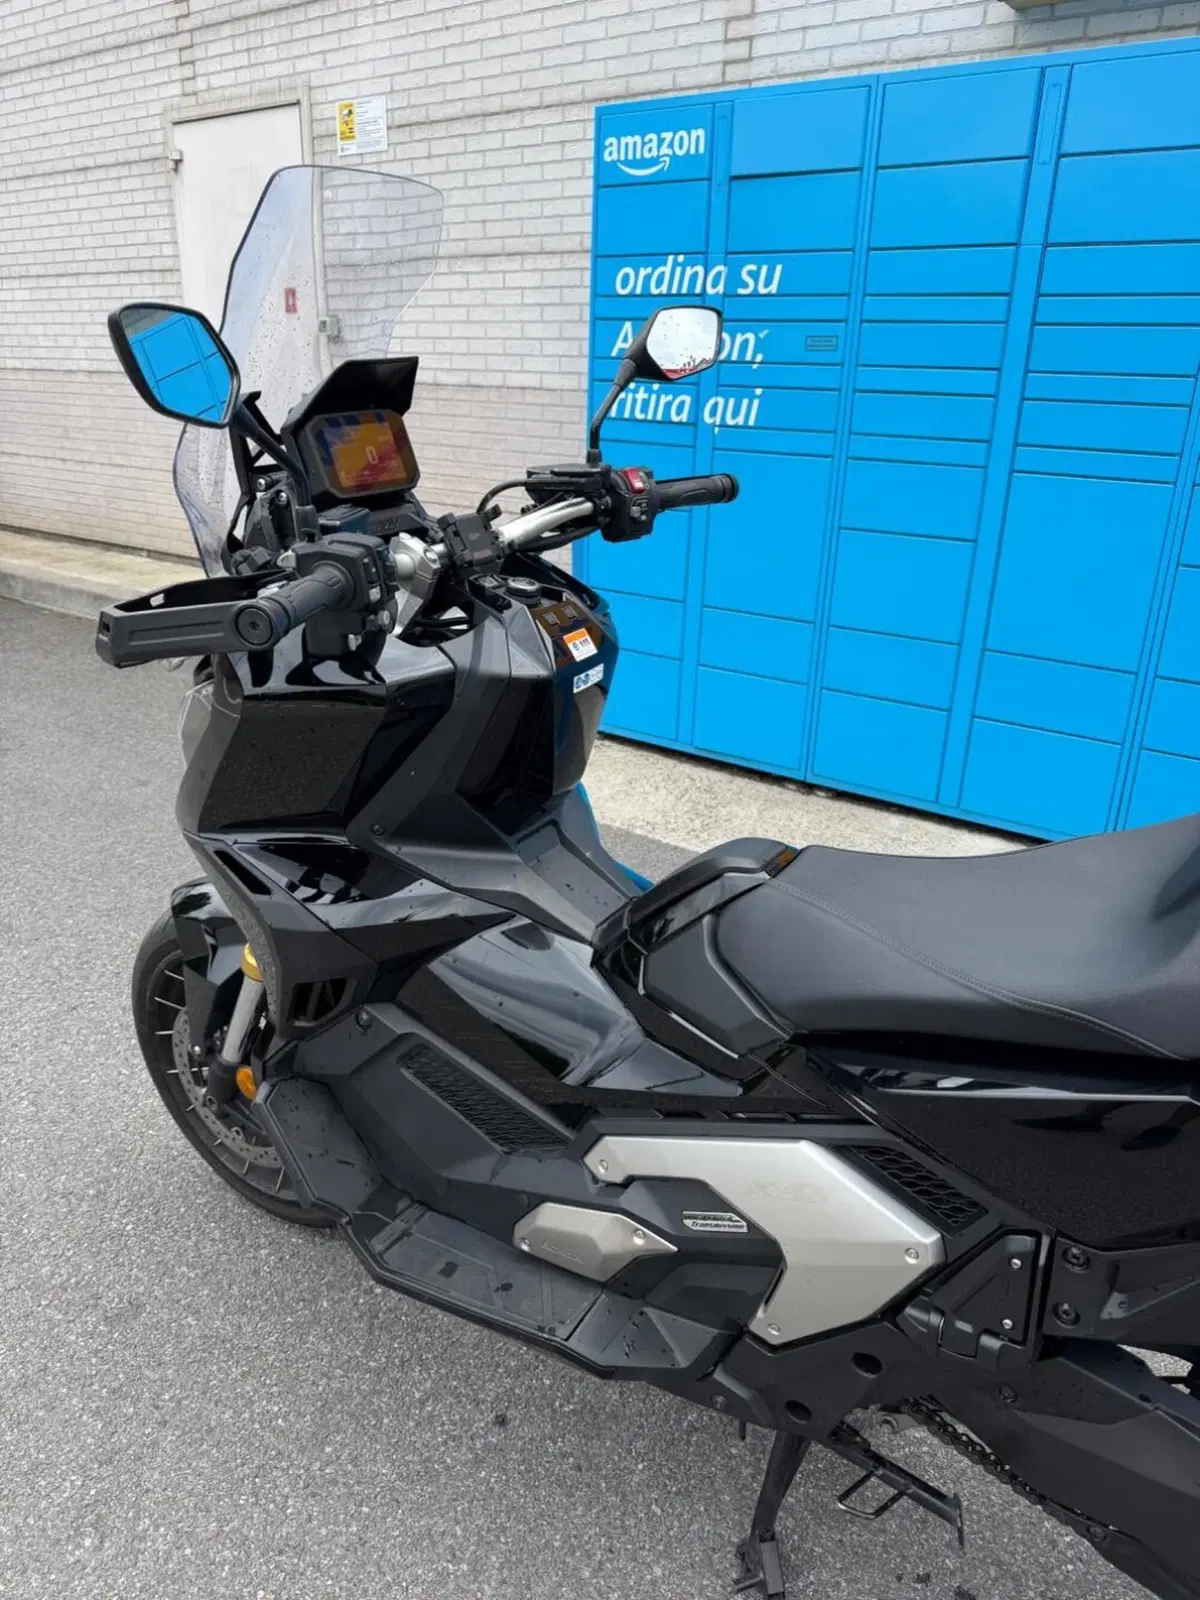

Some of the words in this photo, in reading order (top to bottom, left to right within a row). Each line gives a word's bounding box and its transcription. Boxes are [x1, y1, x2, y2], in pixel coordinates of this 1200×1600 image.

[603, 127, 705, 163] amazon
[615, 254, 727, 295] ordina
[737, 263, 783, 294] su
[611, 382, 691, 422] ritira
[704, 388, 762, 433] qui
